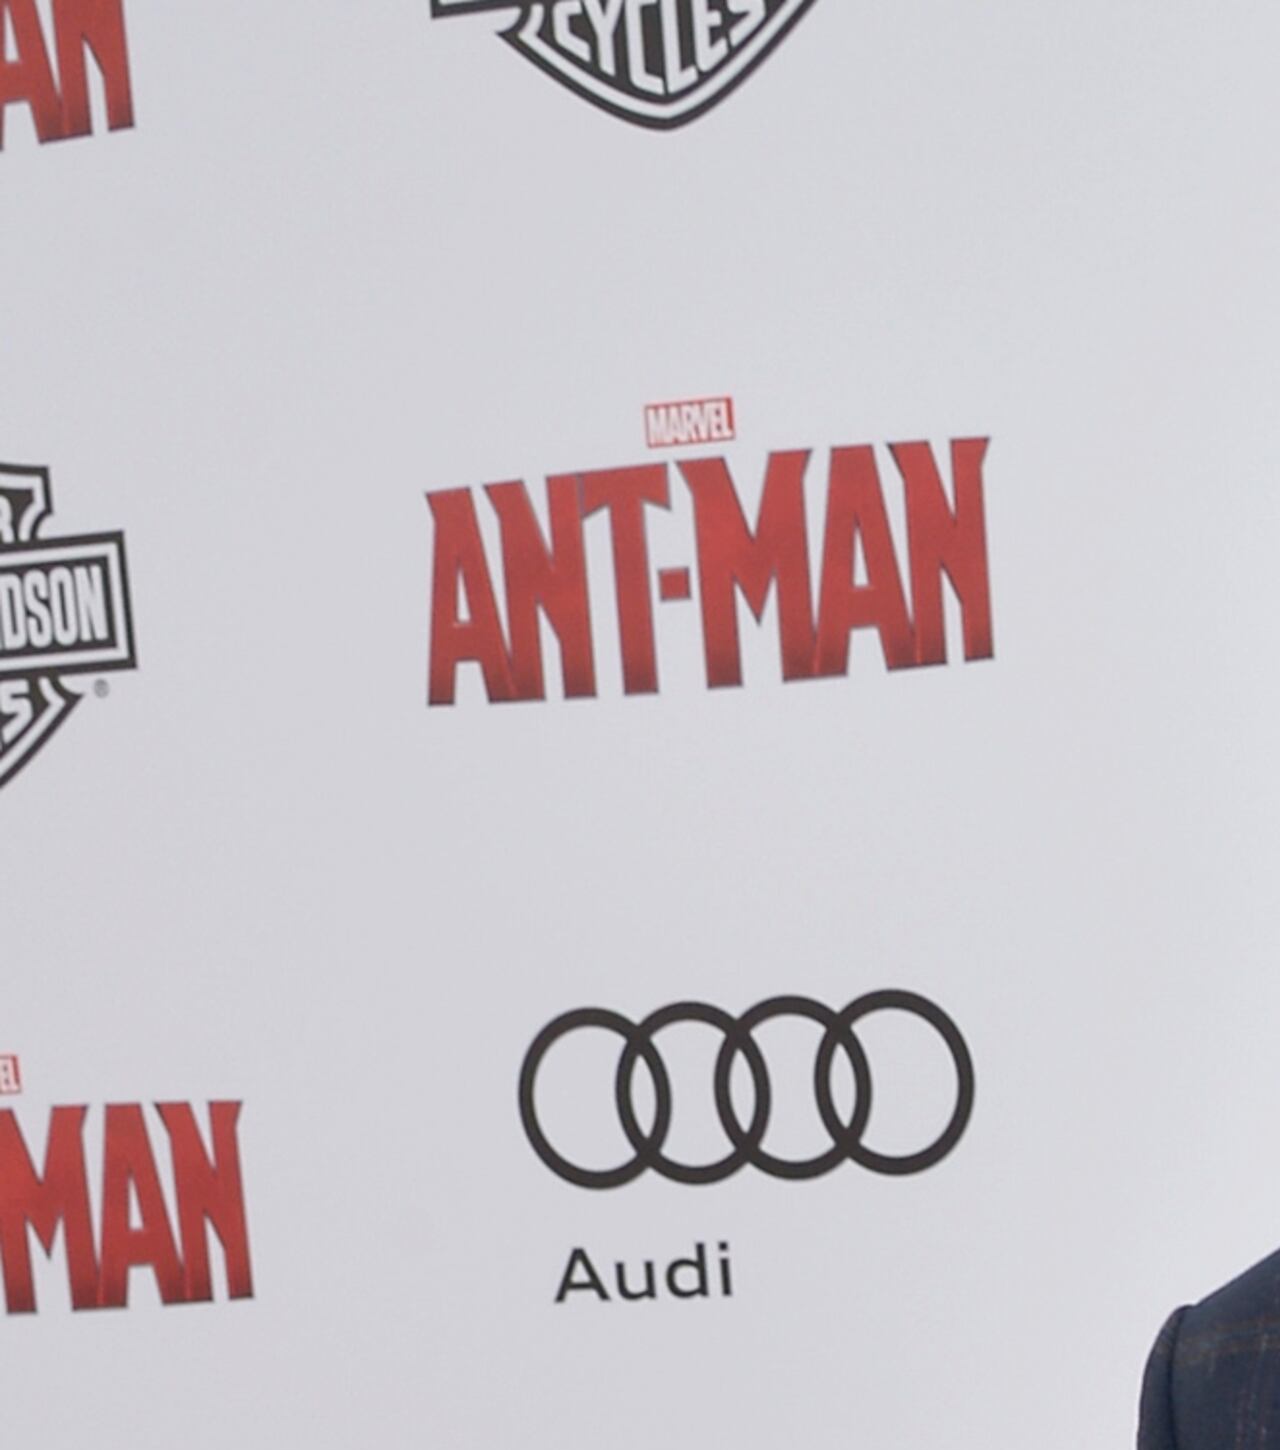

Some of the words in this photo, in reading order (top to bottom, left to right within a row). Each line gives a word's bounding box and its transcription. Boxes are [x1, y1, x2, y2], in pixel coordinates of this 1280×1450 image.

[644, 395, 735, 448] MARVEL
[425, 436, 995, 707] ANT-MAN
[554, 1241, 733, 1303] Audi
